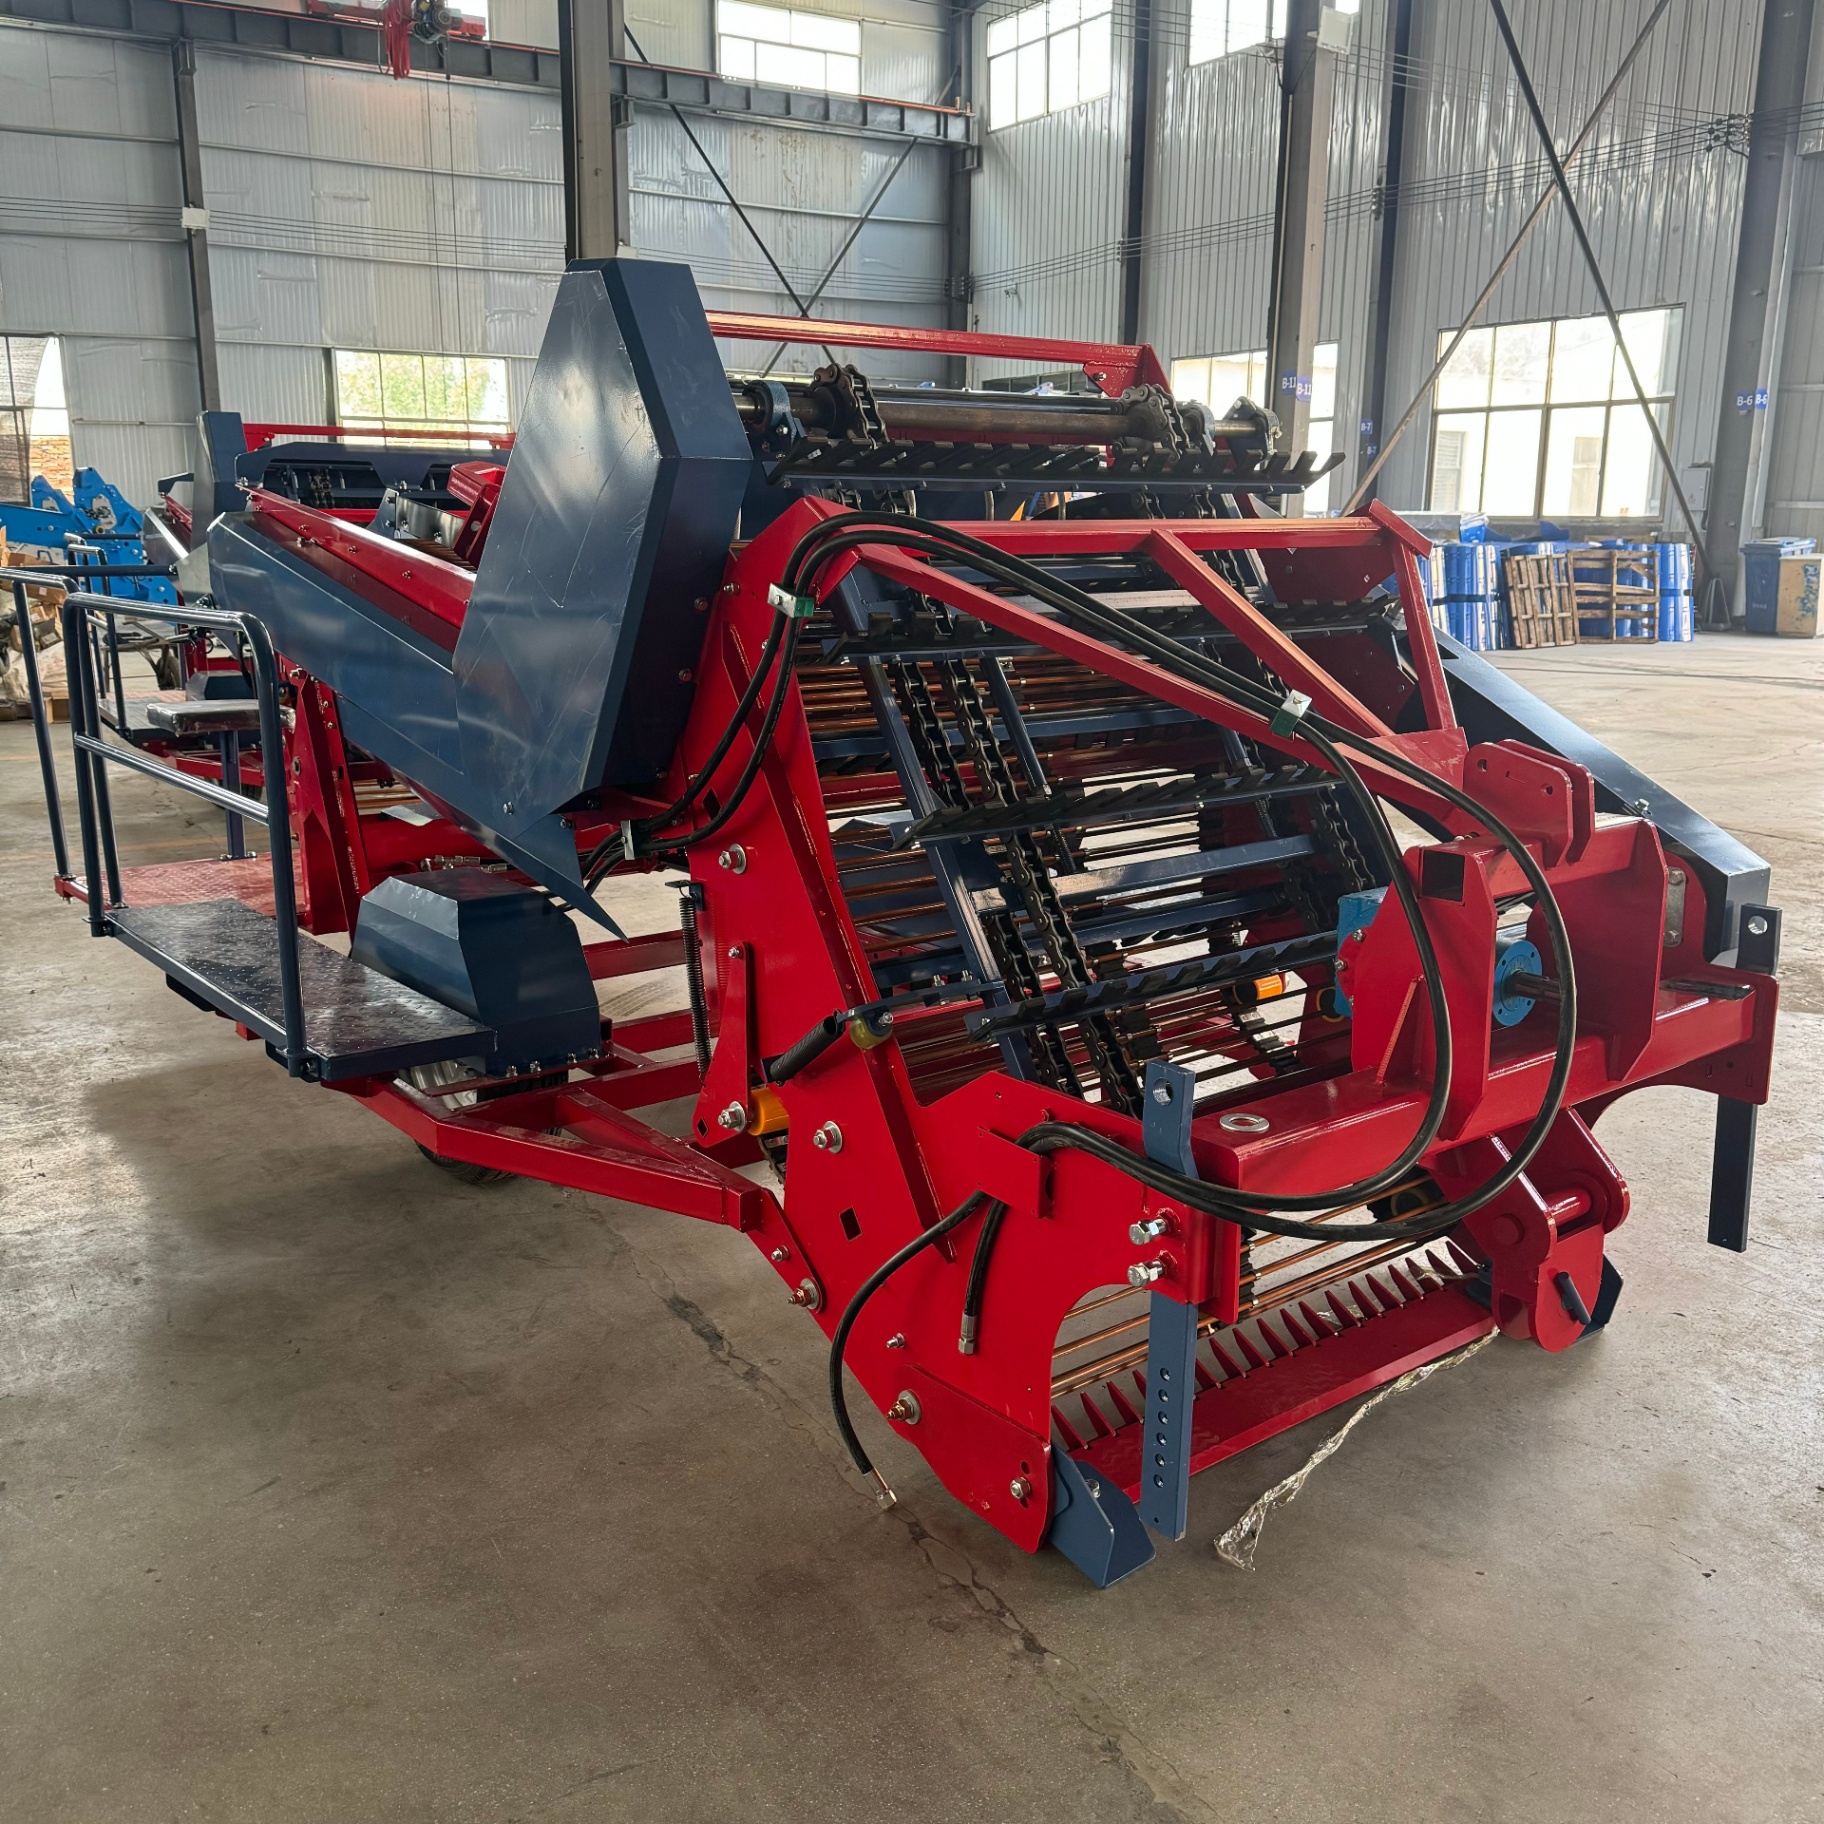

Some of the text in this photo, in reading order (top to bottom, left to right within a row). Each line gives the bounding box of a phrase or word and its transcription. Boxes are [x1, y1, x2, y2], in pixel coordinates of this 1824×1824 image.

[1282, 376, 1297, 389] B-11
[1296, 383, 1312, 395] B-11
[1736, 395, 1753, 406] B-6
[1755, 394, 1768, 405] B-6
